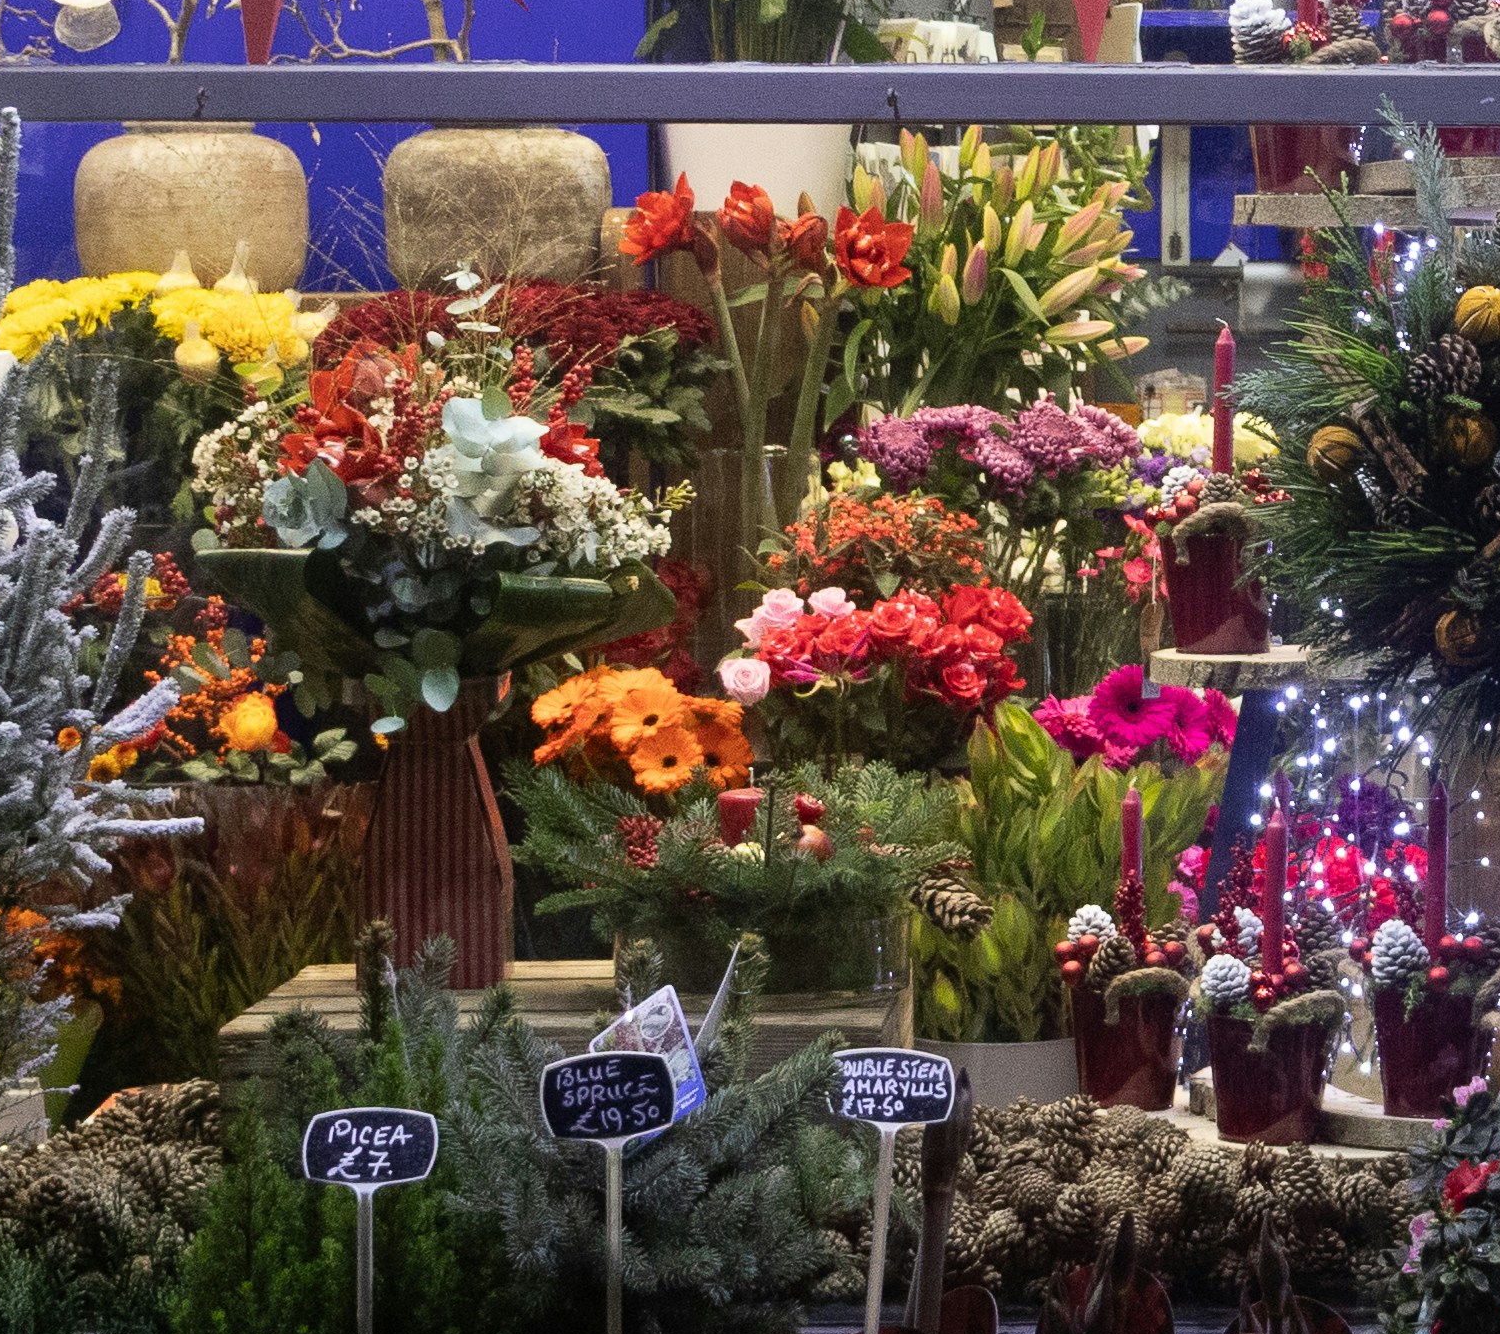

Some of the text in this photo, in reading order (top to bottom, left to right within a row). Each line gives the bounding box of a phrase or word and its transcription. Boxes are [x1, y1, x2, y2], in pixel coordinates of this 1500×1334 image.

[556, 1059, 621, 1090] BLUE
[897, 1059, 946, 1081] STEM
[563, 1073, 659, 1107] SPRUCE
[327, 1119, 414, 1145] PICEA
